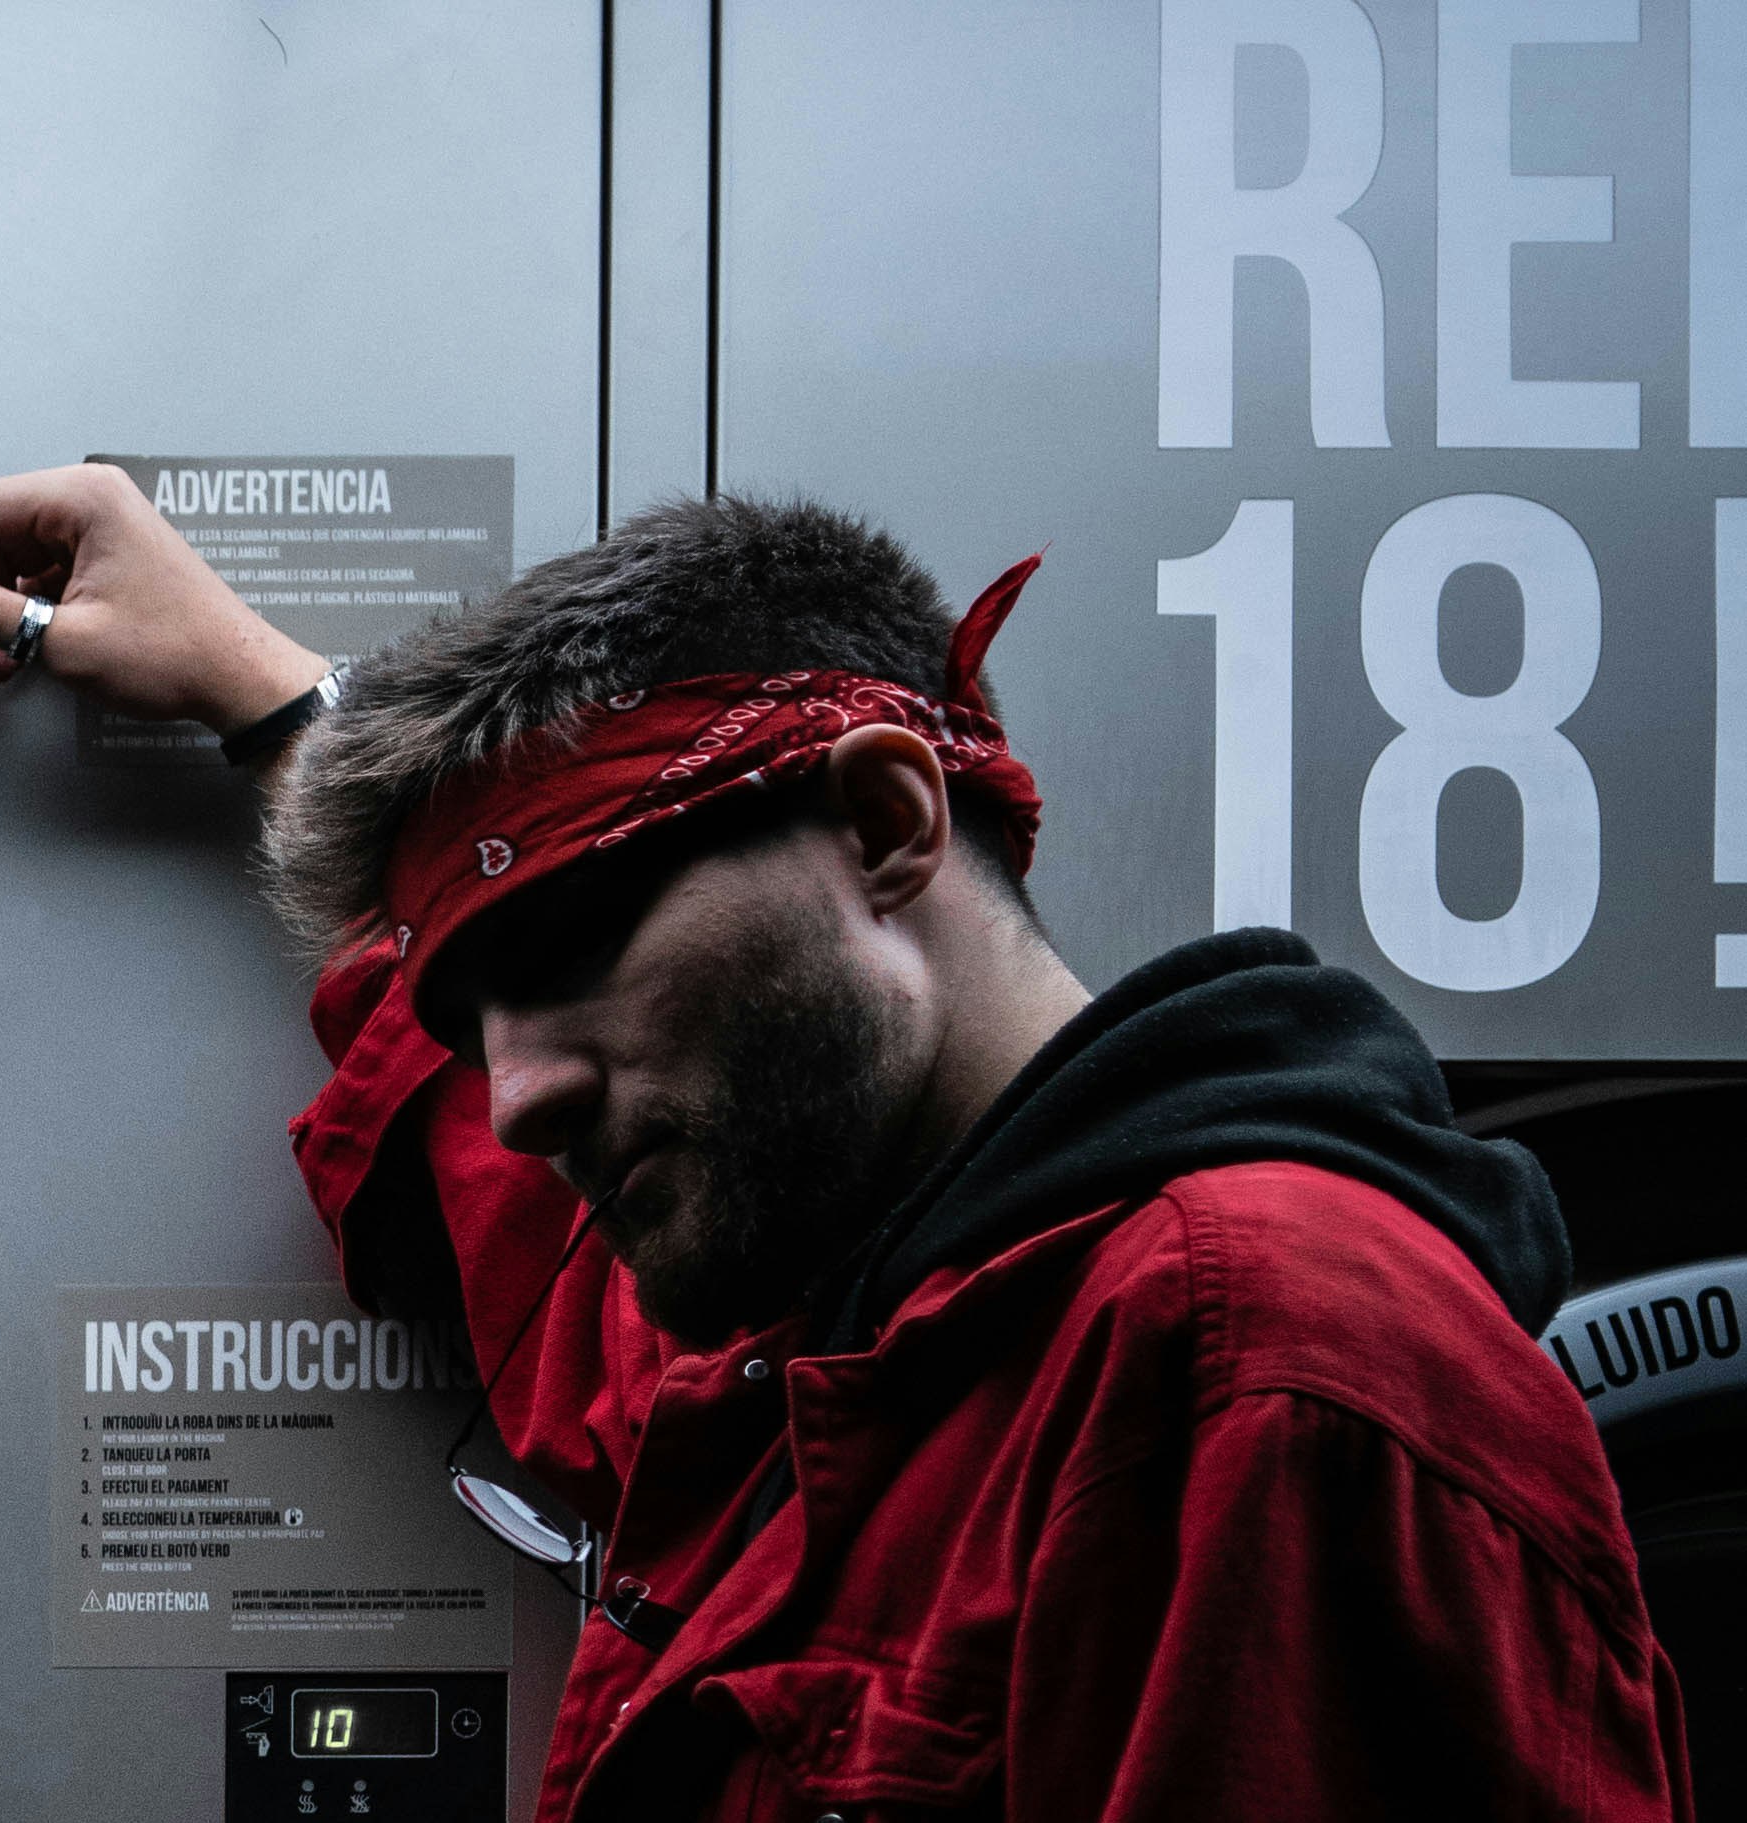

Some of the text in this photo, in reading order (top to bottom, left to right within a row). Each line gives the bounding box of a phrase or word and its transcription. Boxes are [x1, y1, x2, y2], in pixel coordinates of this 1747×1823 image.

[1158, 0, 1747, 449] RE
[155, 468, 392, 515] ADVERTENCIA
[1156, 492, 1602, 992] 18
[166, 1416, 179, 1429] LA
[183, 1416, 213, 1429] ROBA
[216, 1416, 243, 1429] DINS
[246, 1416, 260, 1429] DE
[264, 1416, 278, 1429] LA
[81, 1448, 211, 1461] 2. TANQUEU LA PORTA
[81, 1480, 229, 1494] 3. EFECTUI EL PAGAMENT
[81, 1511, 281, 1526] 4. SELECCIONEU LA TEMPERATURA
[102, 1544, 147, 1558] PREMEU
[151, 1544, 164, 1558] EL
[309, 1708, 353, 1749] 10
